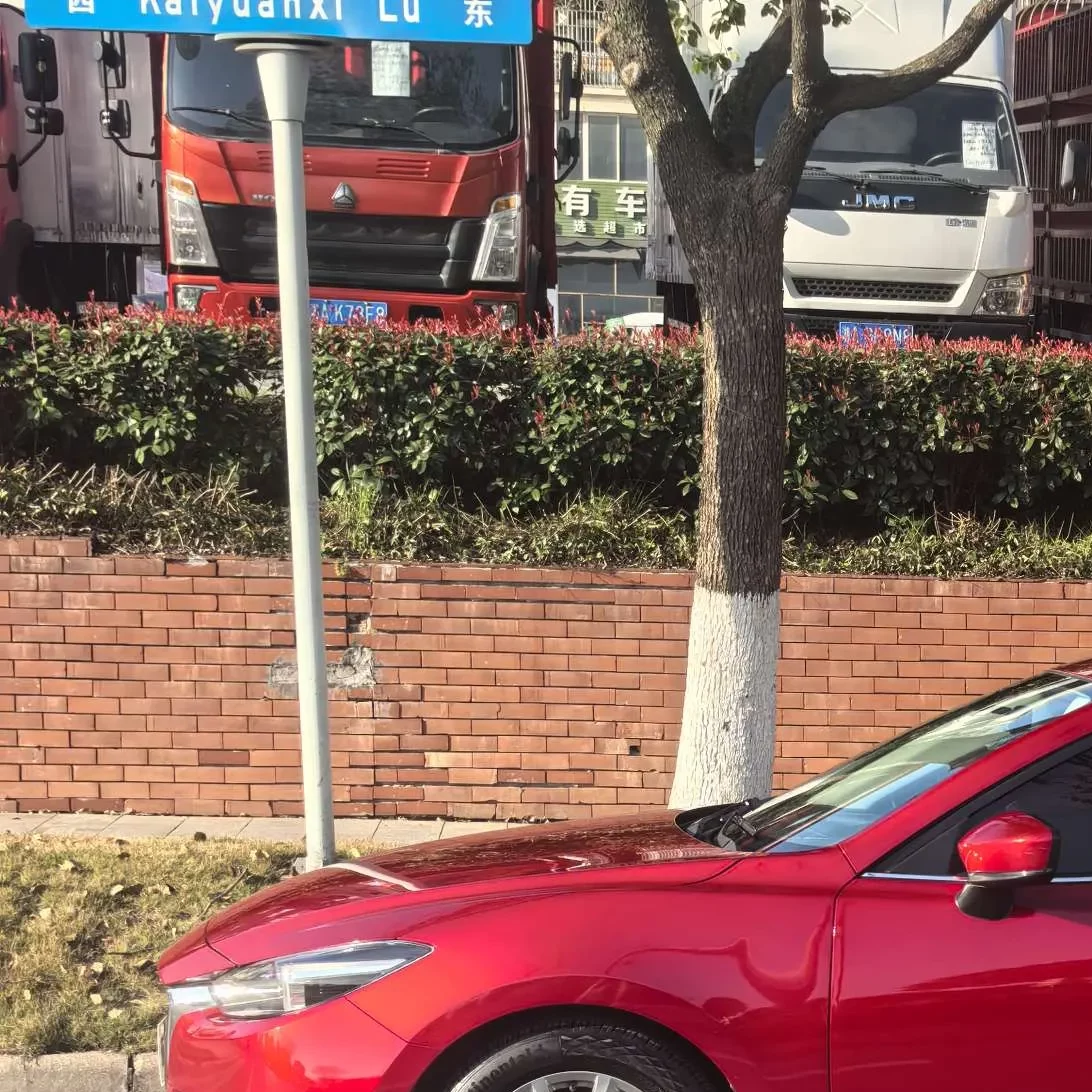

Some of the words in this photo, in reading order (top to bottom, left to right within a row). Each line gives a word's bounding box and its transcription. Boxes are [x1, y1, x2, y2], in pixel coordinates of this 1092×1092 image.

[378, 0, 421, 24] Lu
[463, 0, 494, 29] 东
[841, 192, 916, 210] JMC
